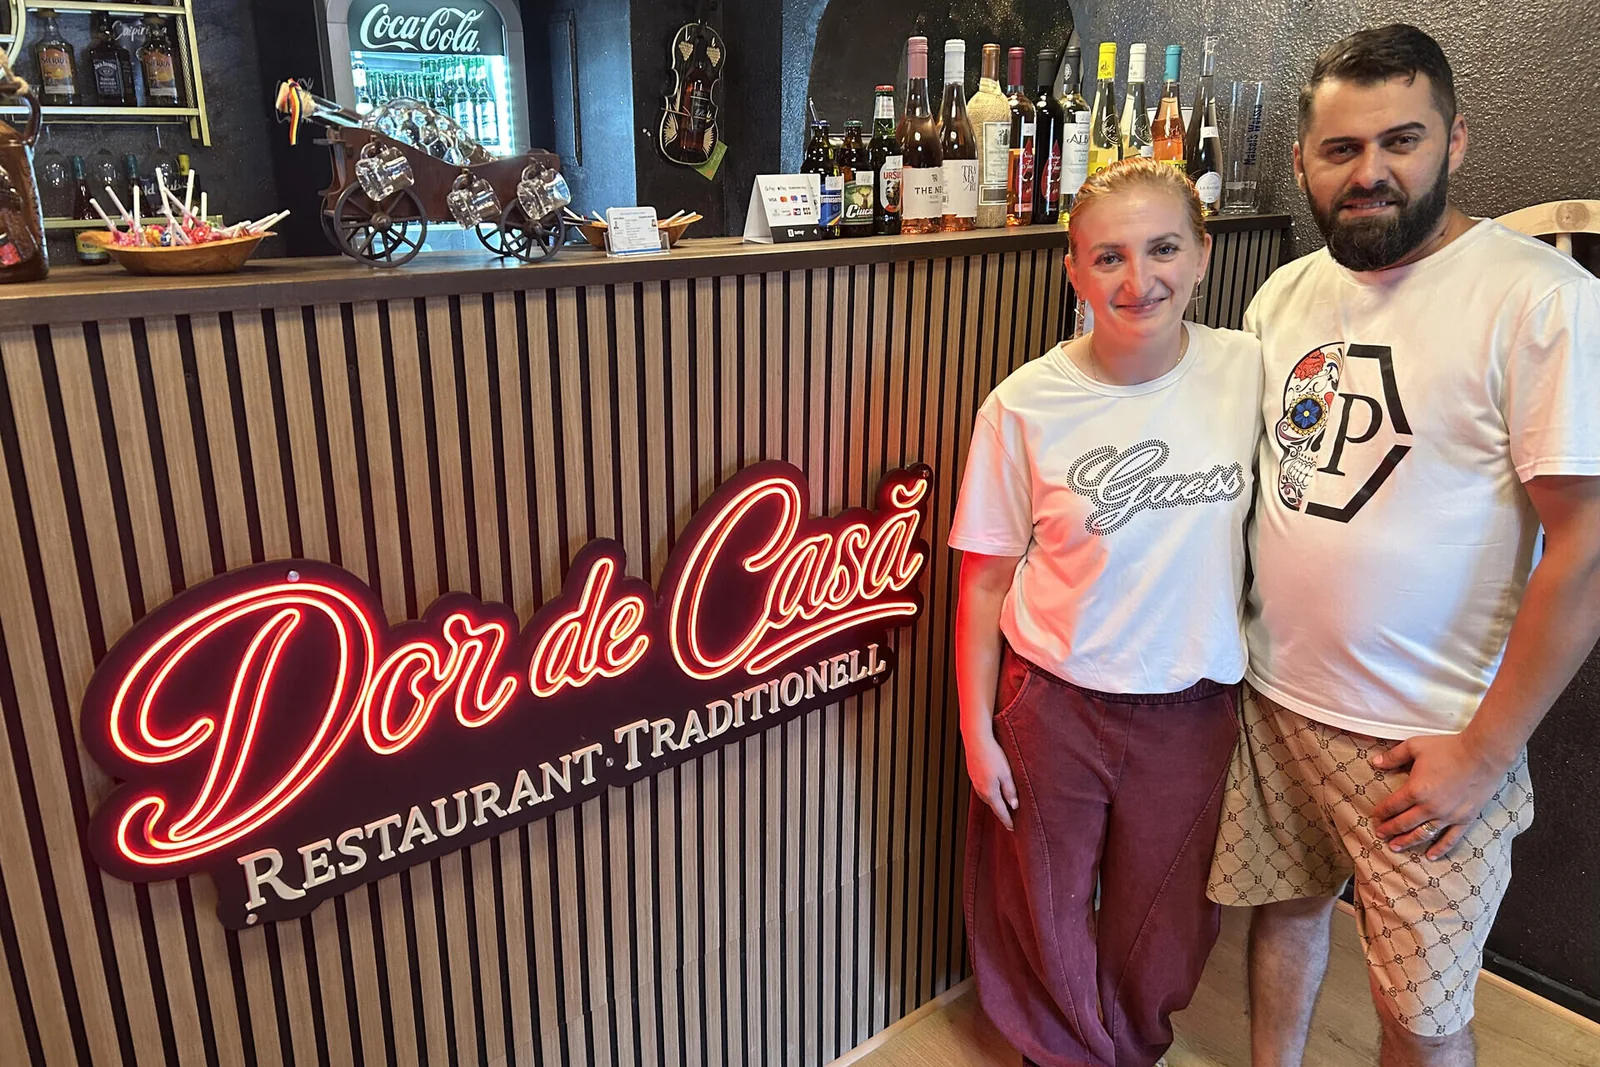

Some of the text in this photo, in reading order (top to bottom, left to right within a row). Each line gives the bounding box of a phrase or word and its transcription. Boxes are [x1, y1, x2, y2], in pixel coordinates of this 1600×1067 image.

[359, 3, 484, 52] Coca-Cola
[914, 186, 933, 195] THE
[1066, 439, 1246, 536] Guess
[109, 477, 928, 865] Dor de Casă
[237, 643, 887, 911] RESTAURANT TRADITIONELL
